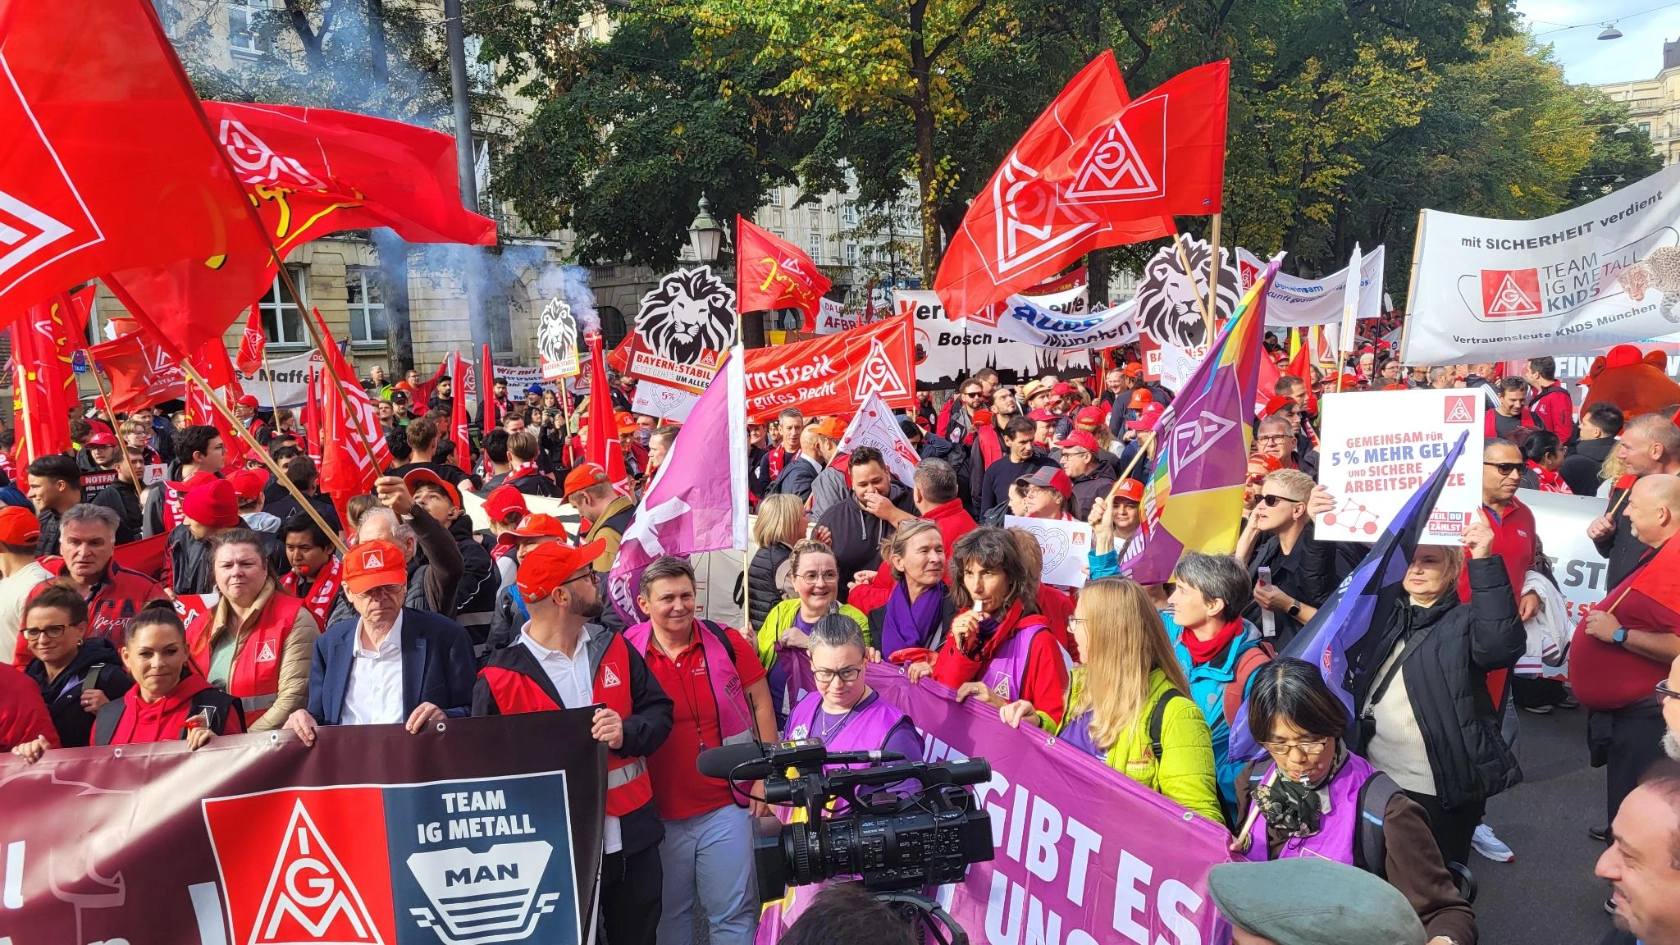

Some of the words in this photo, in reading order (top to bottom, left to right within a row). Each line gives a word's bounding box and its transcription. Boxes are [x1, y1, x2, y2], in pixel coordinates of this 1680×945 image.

[1461, 236, 1481, 248] mit
[1486, 221, 1595, 250] SICHERHEIT
[1600, 190, 1663, 227] verdient
[1542, 252, 1598, 280] TEAM
[1545, 282, 1566, 297] IG
[1574, 250, 1643, 290] METALL
[1547, 283, 1600, 312] KNDS
[1453, 331, 1552, 345] Vertrauensleute
[1555, 321, 1594, 337] KNDS
[1597, 303, 1657, 327] München
[938, 332, 992, 346] Bosch
[259, 368, 319, 384] Maffei
[636, 354, 712, 380] BAYERN:STABIL
[745, 354, 838, 391] rnstreik
[1554, 356, 1594, 377] FIN
[676, 374, 688, 383] UM
[688, 378, 710, 389] ALLES
[661, 391, 675, 400] 5%
[754, 392, 796, 409] gutes
[797, 382, 837, 401] Recht
[1346, 431, 1423, 449] GEMEINSAM
[1426, 432, 1443, 442] FÜR
[1332, 452, 1341, 467] 5
[1344, 450, 1360, 465] %
[1364, 446, 1414, 464] MEHR
[1348, 469, 1367, 478] UND
[1368, 462, 1423, 477] SICHERE
[1344, 473, 1466, 493] ARBEITSPLZE
[1449, 512, 1461, 521] DU
[1563, 559, 1608, 591] ST
[442, 790, 506, 813] TEAM
[417, 822, 442, 844] IG
[448, 814, 536, 840] METALL
[974, 770, 1102, 907] GIBT
[1112, 849, 1203, 945] ES
[445, 863, 519, 887] MAN
[984, 869, 1101, 945] UN
